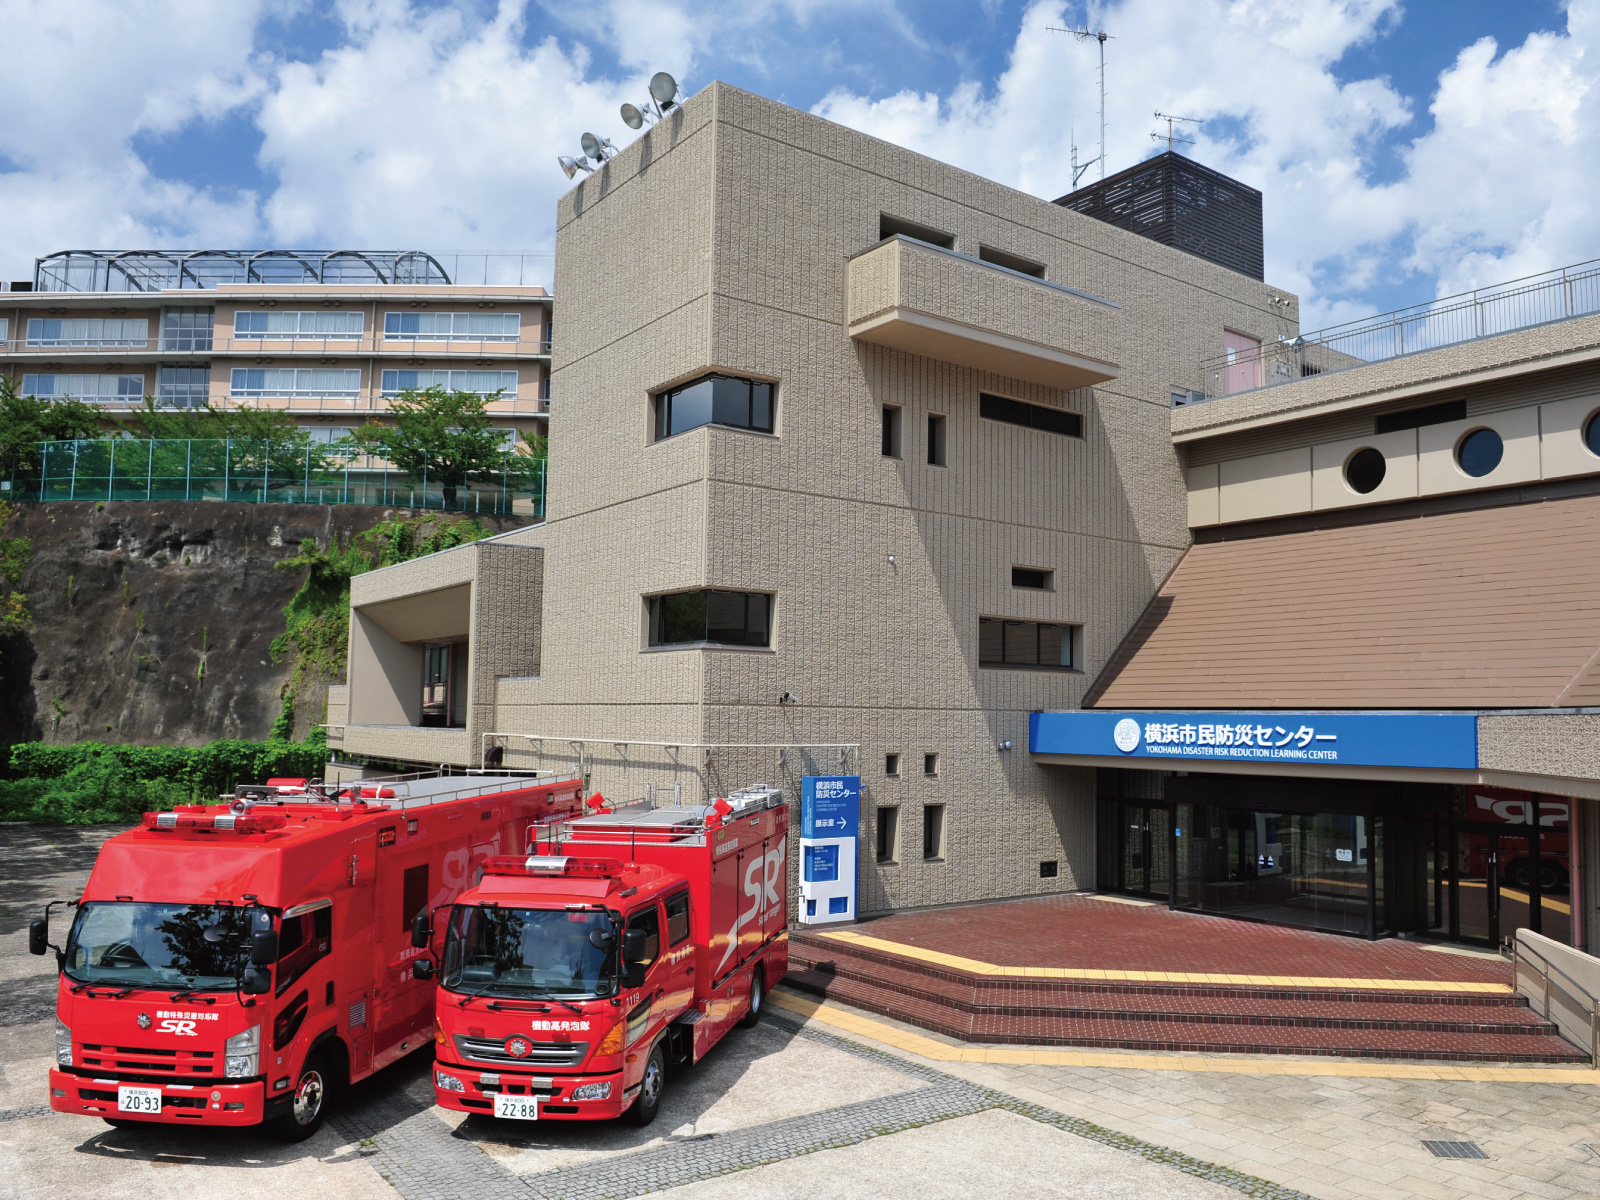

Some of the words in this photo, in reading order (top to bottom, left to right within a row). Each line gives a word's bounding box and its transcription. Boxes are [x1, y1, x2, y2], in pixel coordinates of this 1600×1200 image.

[1144, 723, 1338, 748] 横浜市民防災センター
[1146, 745, 1182, 755] YOKOHAMA
[1183, 746, 1213, 756] DISASTER
[1214, 747, 1229, 756] RISK
[1229, 748, 1270, 758] REDUCTION
[1270, 749, 1307, 759] LEARNING
[1308, 750, 1338, 760] CENTER
[815, 780, 844, 790] 横浜市民
[815, 789, 857, 799] 防災センター
[156, 1010, 219, 1021] 機動特殊災害対応隊
[156, 1020, 199, 1034] SR
[531, 1020, 591, 1031] 機動高発泡隊
[125, 1095, 160, 1112] 20-93
[502, 1103, 536, 1118] 22-88
